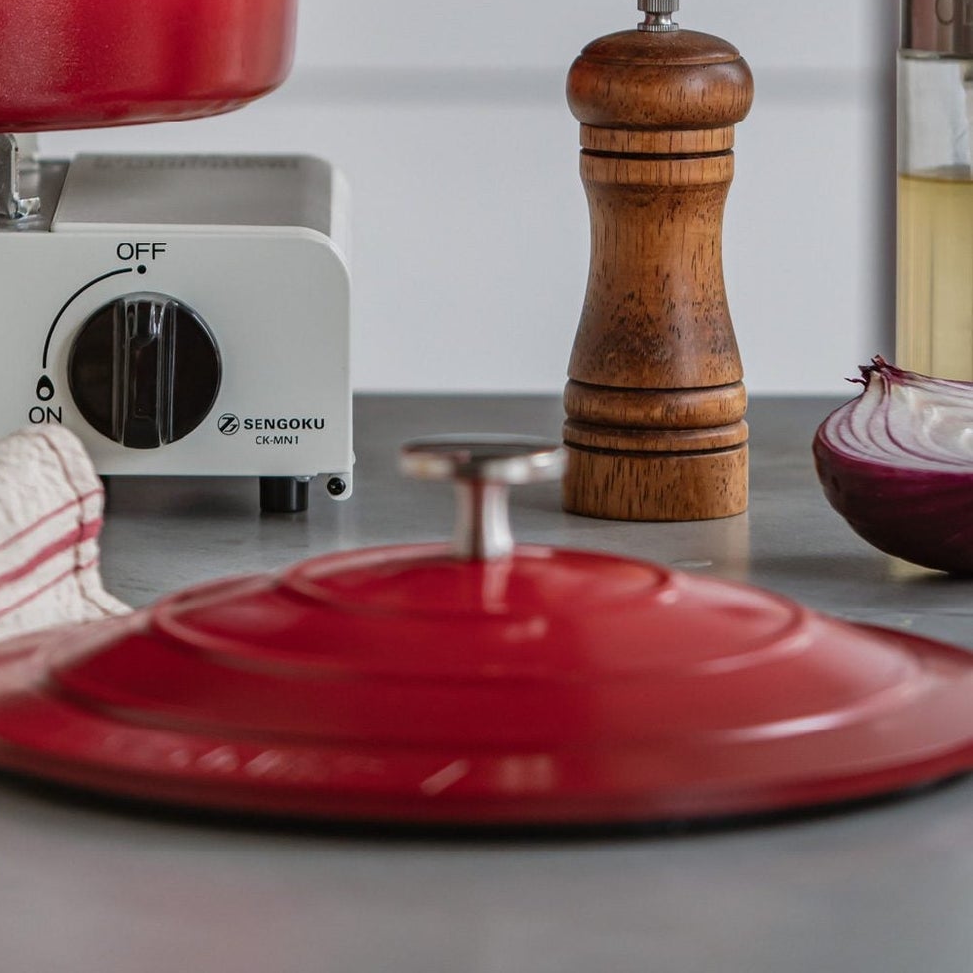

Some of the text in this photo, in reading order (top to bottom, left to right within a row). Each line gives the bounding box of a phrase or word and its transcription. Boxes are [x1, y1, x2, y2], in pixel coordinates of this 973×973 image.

[116, 242, 167, 260] OFF
[28, 406, 63, 425] ON
[243, 418, 325, 430] SENGOKU
[255, 435, 299, 445] CK-MN1
